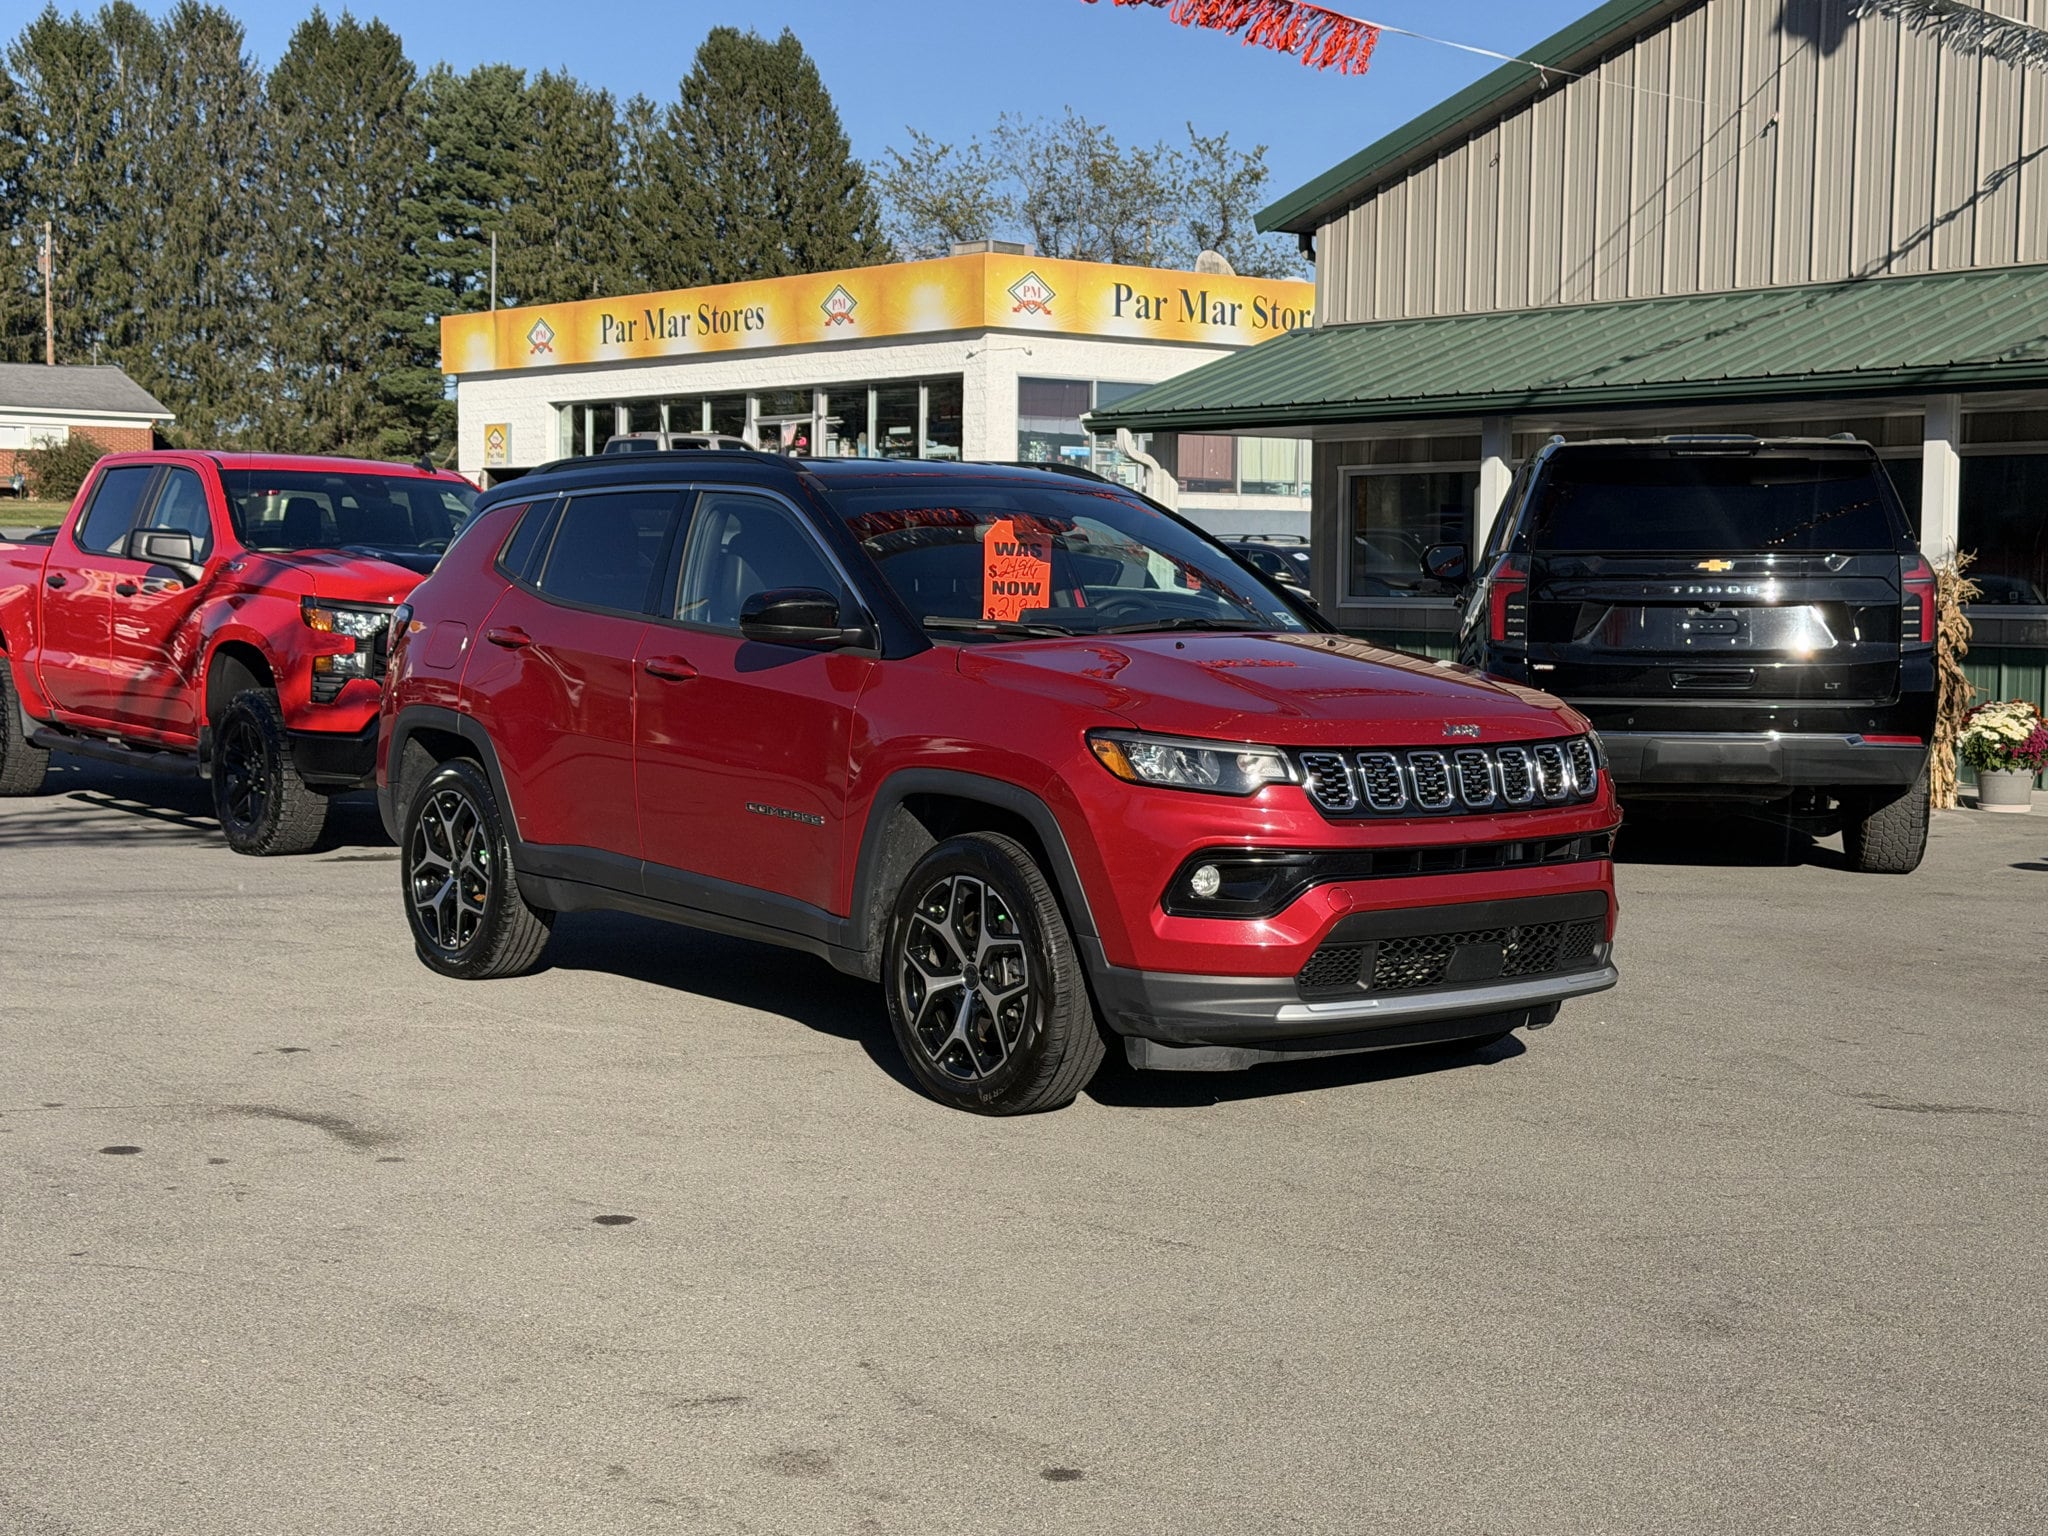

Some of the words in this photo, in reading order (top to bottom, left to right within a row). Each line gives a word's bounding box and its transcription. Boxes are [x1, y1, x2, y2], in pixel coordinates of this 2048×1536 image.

[1023, 285, 1041, 298] PM
[1112, 282, 1168, 320] Par
[1177, 288, 1242, 327] Mar
[1251, 294, 1315, 331] Stor
[601, 313, 638, 345] Par
[643, 307, 691, 341] Mar
[697, 303, 765, 336] Stores
[994, 541, 1043, 557] WAS
[992, 580, 1041, 597] NOW
[1824, 682, 1841, 690] LT
